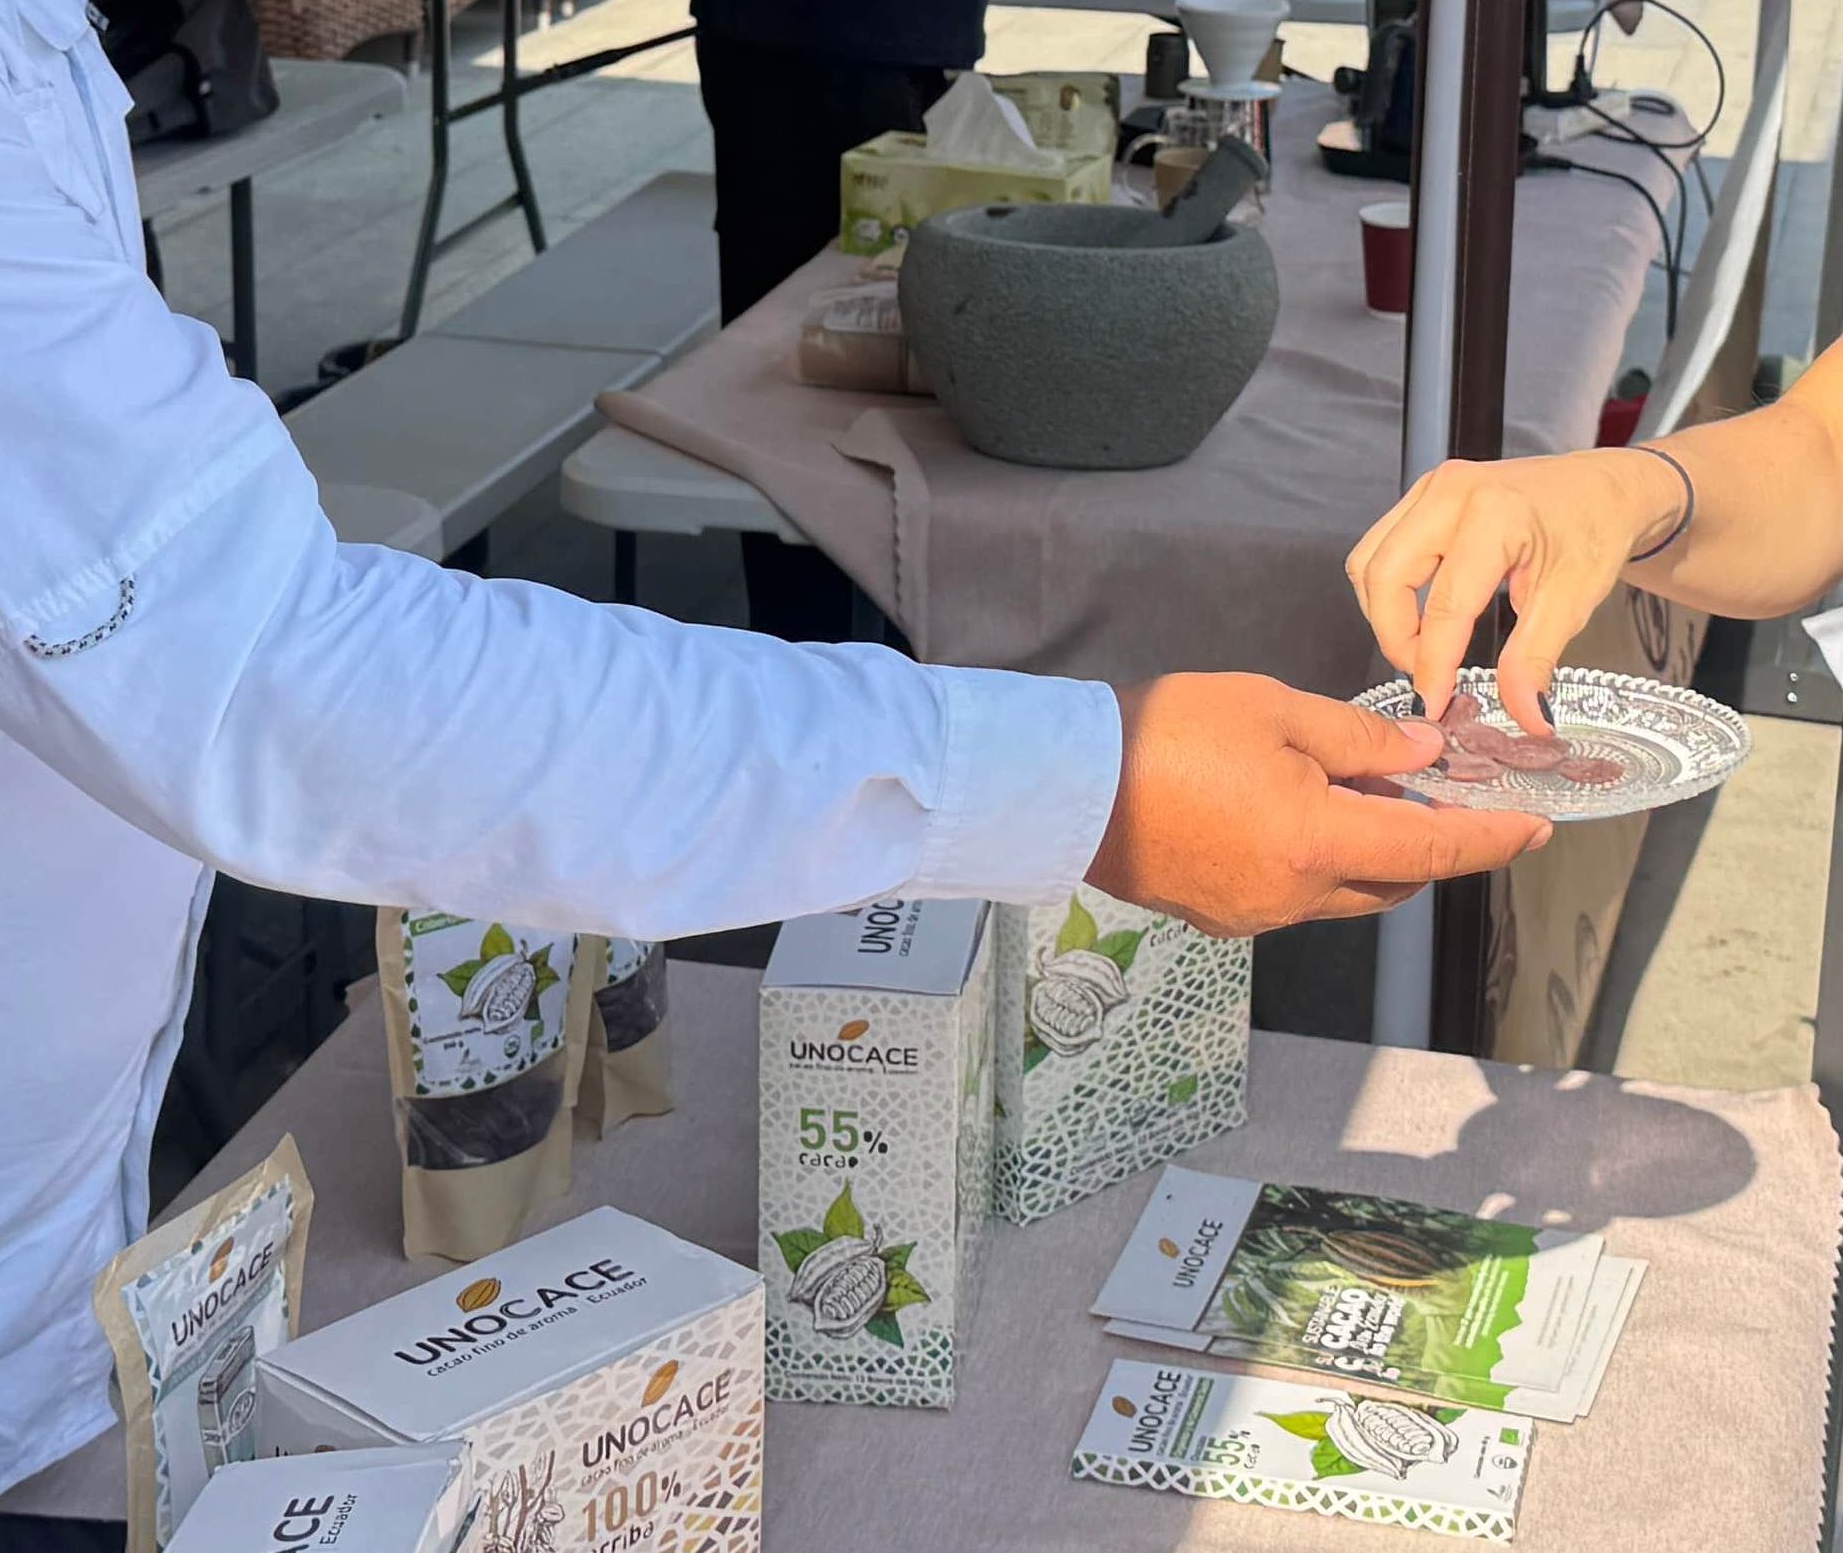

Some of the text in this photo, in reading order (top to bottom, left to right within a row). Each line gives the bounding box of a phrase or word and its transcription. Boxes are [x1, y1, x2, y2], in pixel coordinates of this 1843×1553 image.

[858, 899, 904, 954] UNOC
[790, 1041, 919, 1067] UNOCACE
[799, 1107, 888, 1154] 55%
[1172, 1218, 1224, 1289] UNOCACE
[171, 1241, 274, 1347] UNOCACE
[393, 1258, 635, 1365] UNOCACE
[427, 1353, 472, 1377] cacao
[530, 1305, 578, 1332] aroma
[586, 1277, 649, 1305] Ecuador
[582, 1369, 732, 1468] UNOCACE
[1128, 1369, 1182, 1454] UNOCACE
[273, 1495, 335, 1553] CE
[582, 1469, 682, 1542] 100%
